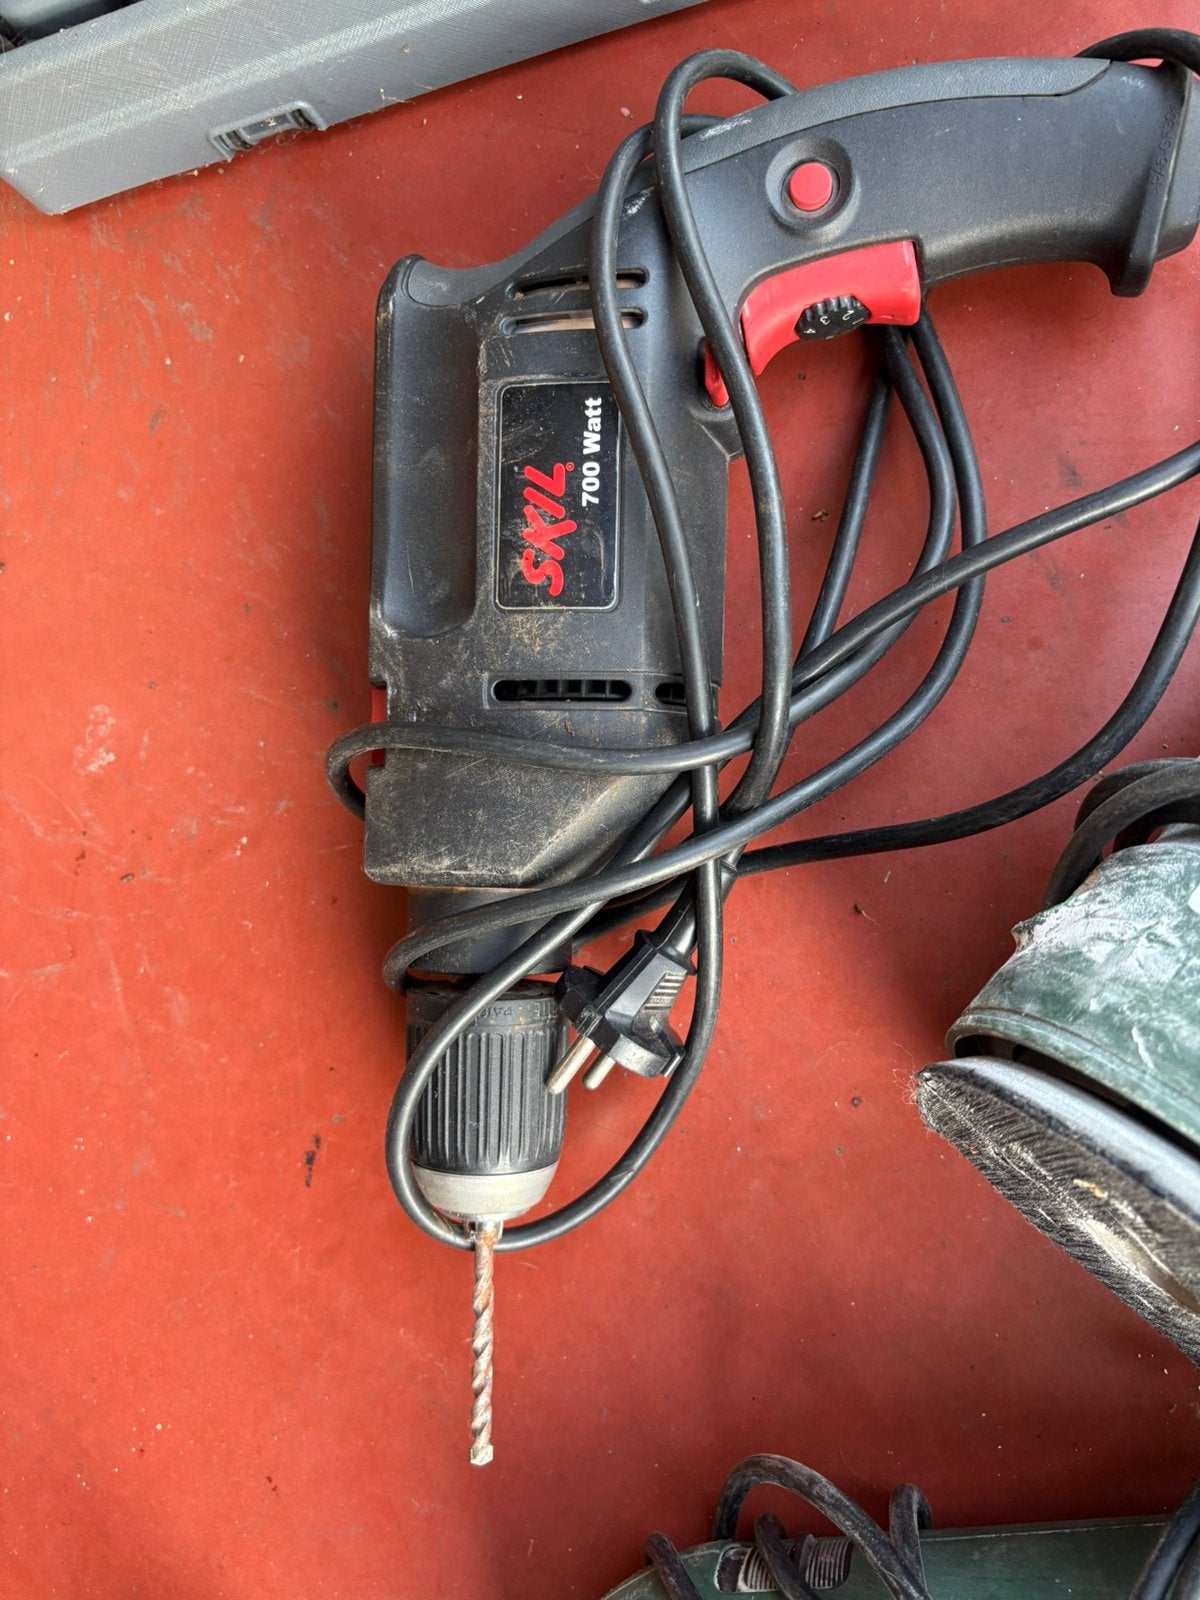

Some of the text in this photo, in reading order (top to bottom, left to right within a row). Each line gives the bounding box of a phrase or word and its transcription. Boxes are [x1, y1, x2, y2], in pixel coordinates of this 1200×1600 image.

[820, 316, 830, 325] 3
[843, 310, 855, 320] 2
[581, 397, 602, 507] 700 Watt
[522, 462, 577, 597] SKIL
